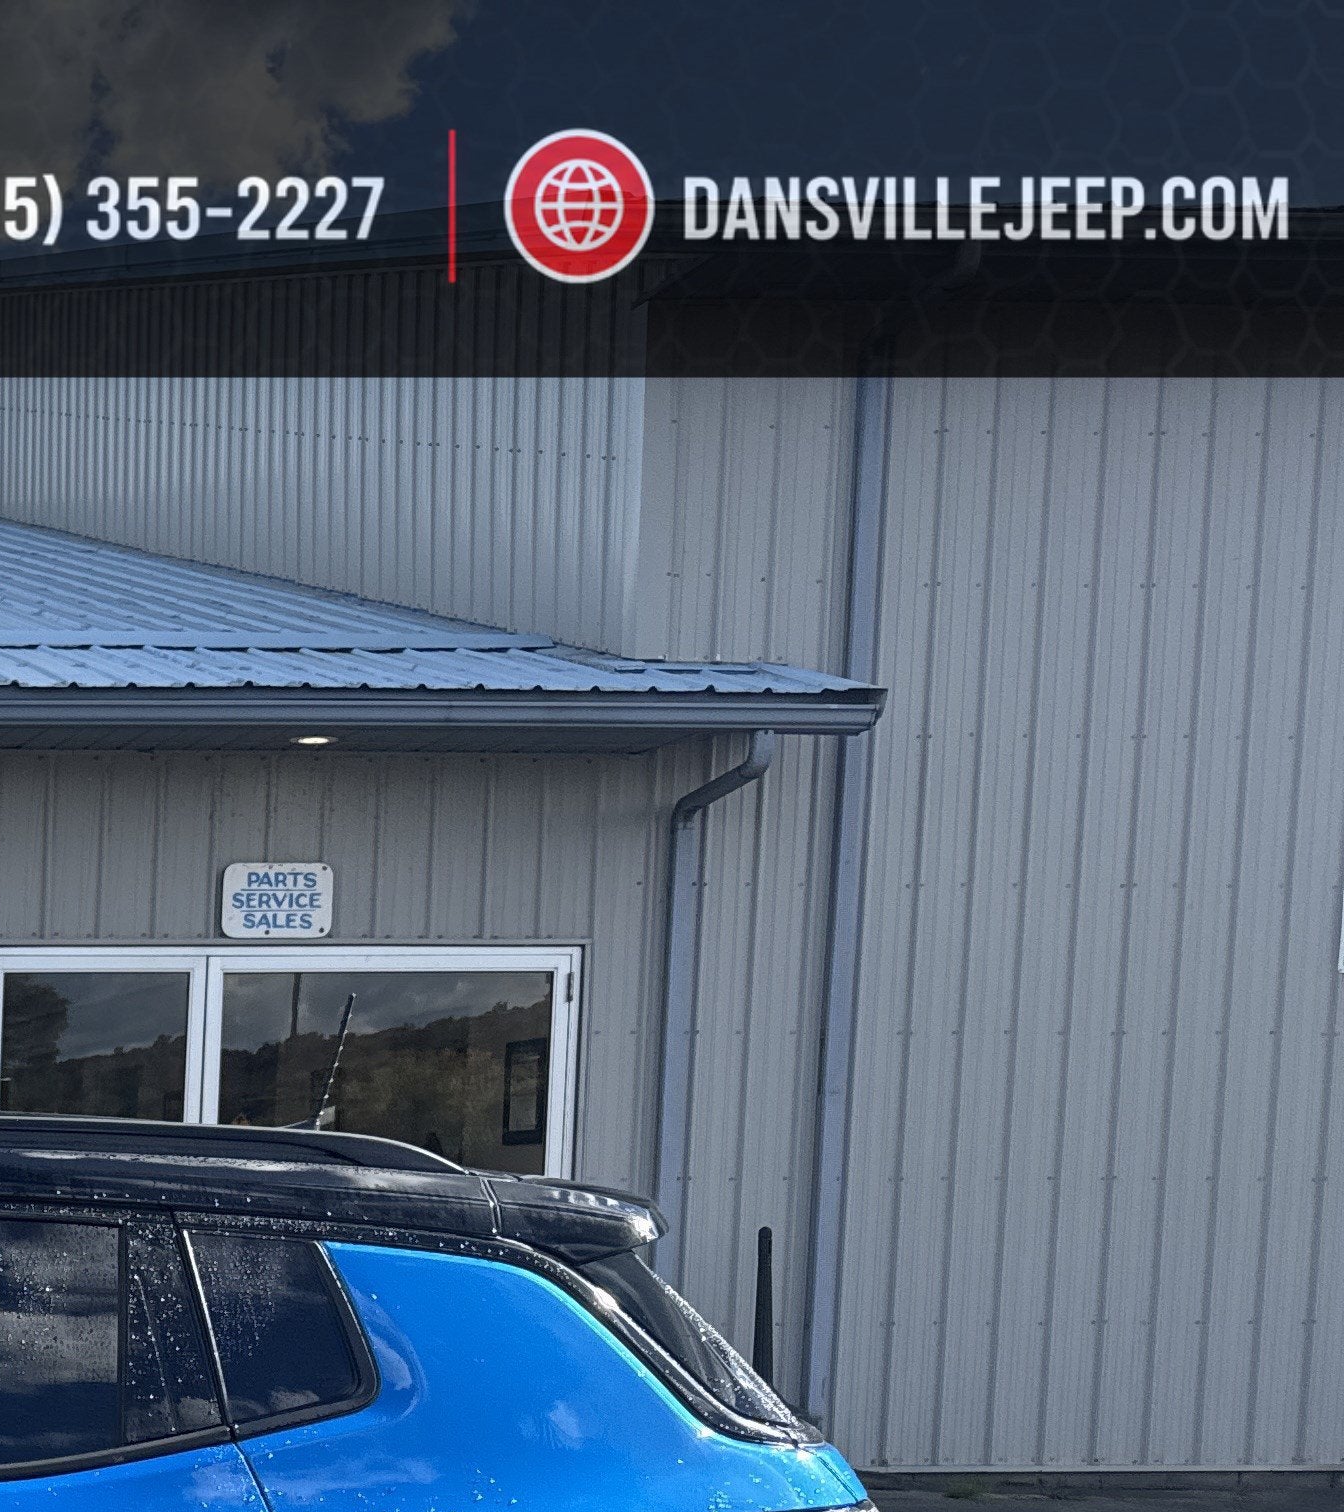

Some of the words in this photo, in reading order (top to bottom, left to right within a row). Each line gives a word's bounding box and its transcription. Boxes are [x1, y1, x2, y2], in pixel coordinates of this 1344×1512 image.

[246, 872, 318, 889] PARTS
[231, 892, 323, 909] SERVICE
[242, 913, 313, 930] SALES
